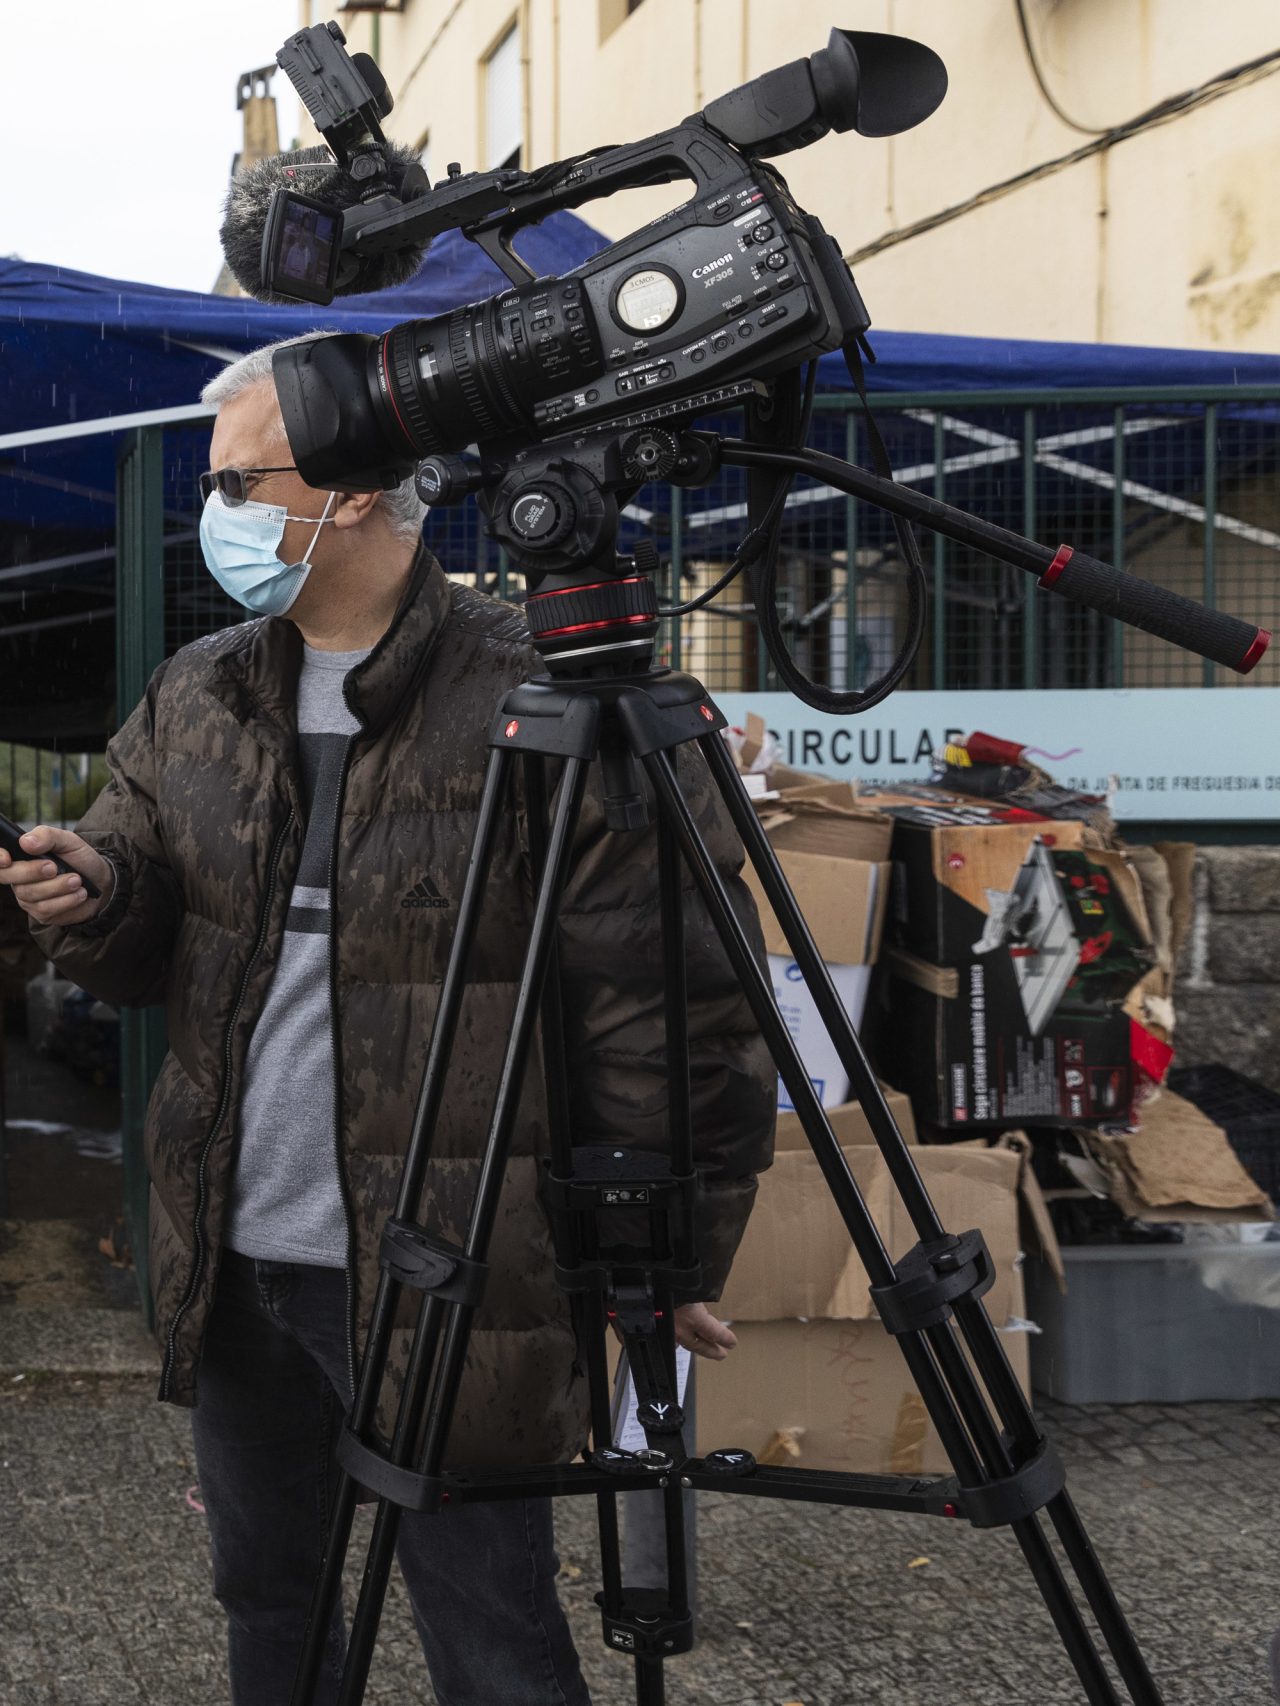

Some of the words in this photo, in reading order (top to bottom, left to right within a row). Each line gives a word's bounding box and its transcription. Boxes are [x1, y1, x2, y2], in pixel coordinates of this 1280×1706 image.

[692, 253, 733, 279] Canon
[635, 276, 655, 287] CMOS
[704, 267, 734, 289] XF305
[644, 314, 661, 328] HD
[525, 505, 536, 522] FLUID
[530, 506, 546, 529] SYSTEM
[1146, 777, 1168, 791] DE
[1172, 776, 1261, 792] FREGUESIA
[401, 896, 450, 908] adidas
[970, 964, 985, 996] banco
[970, 996, 985, 1010] da
[971, 1011, 986, 1046] mobile
[972, 1048, 988, 1094] circolare
[974, 1094, 991, 1120] Sega
